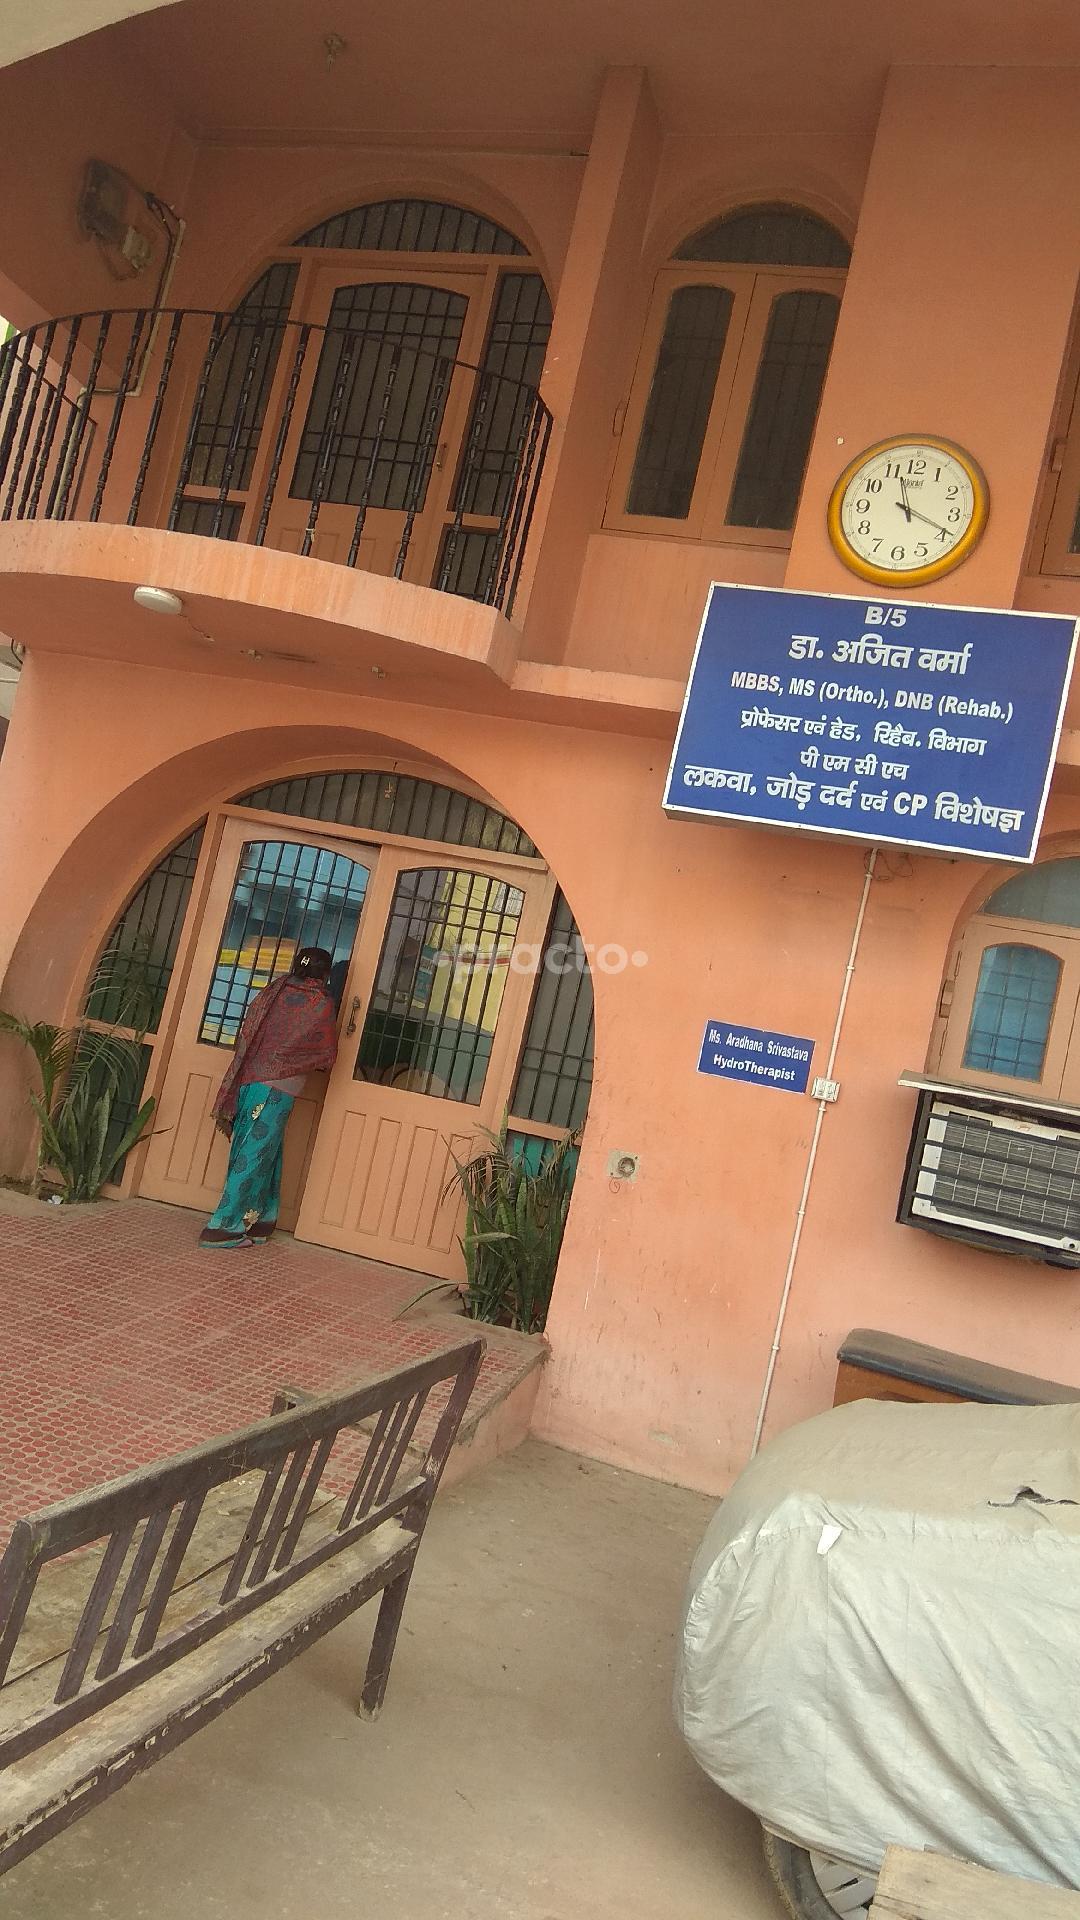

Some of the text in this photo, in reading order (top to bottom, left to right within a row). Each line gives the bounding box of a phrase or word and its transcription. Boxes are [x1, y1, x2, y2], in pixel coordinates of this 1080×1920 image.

[885, 462, 901, 478] 11
[906, 459, 927, 475] 12
[933, 467, 942, 482] 1
[865, 478, 883, 494] 10
[945, 486, 959, 500] 2
[856, 498, 871, 514] 9
[947, 506, 961, 523] 3
[857, 520, 871, 535] 8
[871, 537, 884, 553] 7
[913, 542, 929, 557] 5
[890, 546, 905, 561] 6
[864, 605, 908, 628] B/5
[788, 633, 974, 675] डा. अजित वर्मा
[730, 671, 1014, 724] MBBS, MS (Ortho.), DNB (Rehab.)
[740, 705, 987, 756] प्रोफेसर एवं हेड, रिहैब. विभाग
[800, 745, 910, 781] पी एम सी एच
[683, 764, 1025, 833] लकवा, जोड़ दर्द एवं CP विशेषज्ञ
[708, 1028, 809, 1062] Ms. Aradhana Srivastava
[713, 1053, 796, 1081] HydroTherapist
